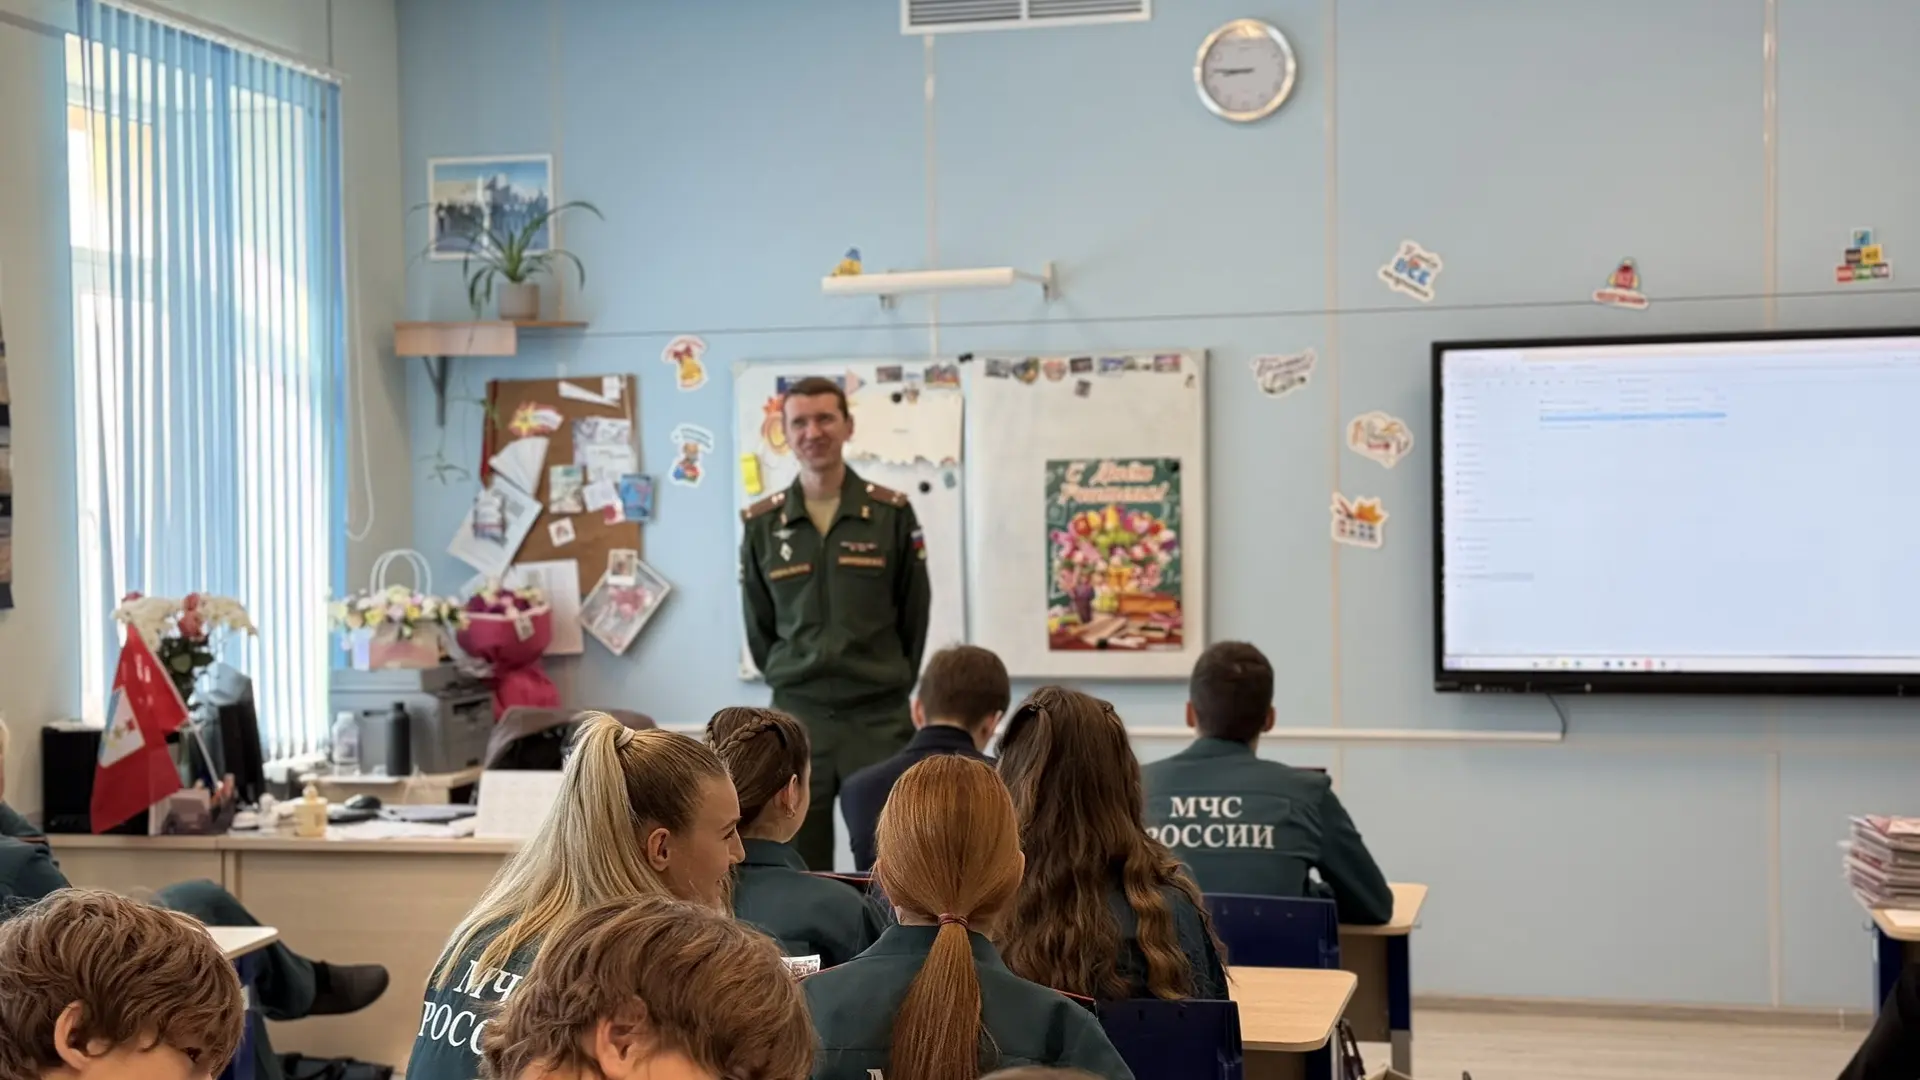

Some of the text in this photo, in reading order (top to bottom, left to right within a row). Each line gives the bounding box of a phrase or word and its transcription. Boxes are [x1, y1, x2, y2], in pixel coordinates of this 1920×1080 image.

[1169, 796, 1243, 818] МЧС
[453, 959, 523, 1002] МЧ
[418, 1001, 498, 1056] РОСС
